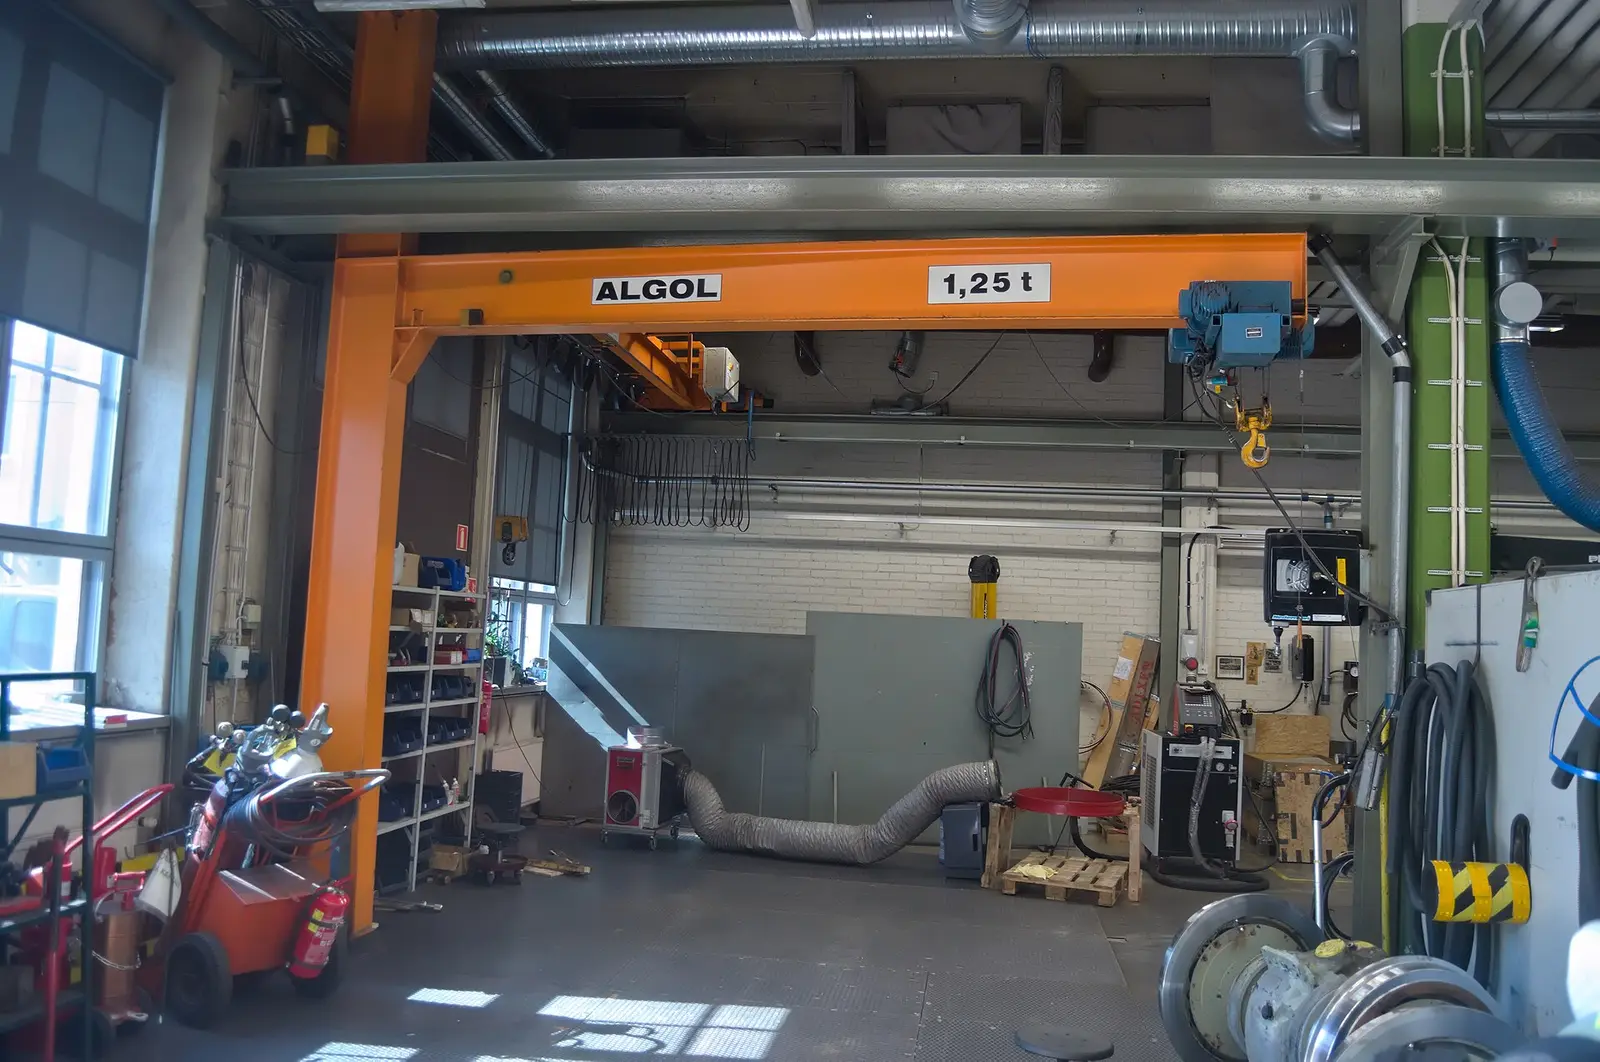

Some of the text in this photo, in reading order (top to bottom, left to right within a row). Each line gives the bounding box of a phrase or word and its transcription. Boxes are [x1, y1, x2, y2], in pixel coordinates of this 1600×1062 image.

[595, 278, 718, 301] ALGOL
[943, 271, 1033, 299] 1,25 t
